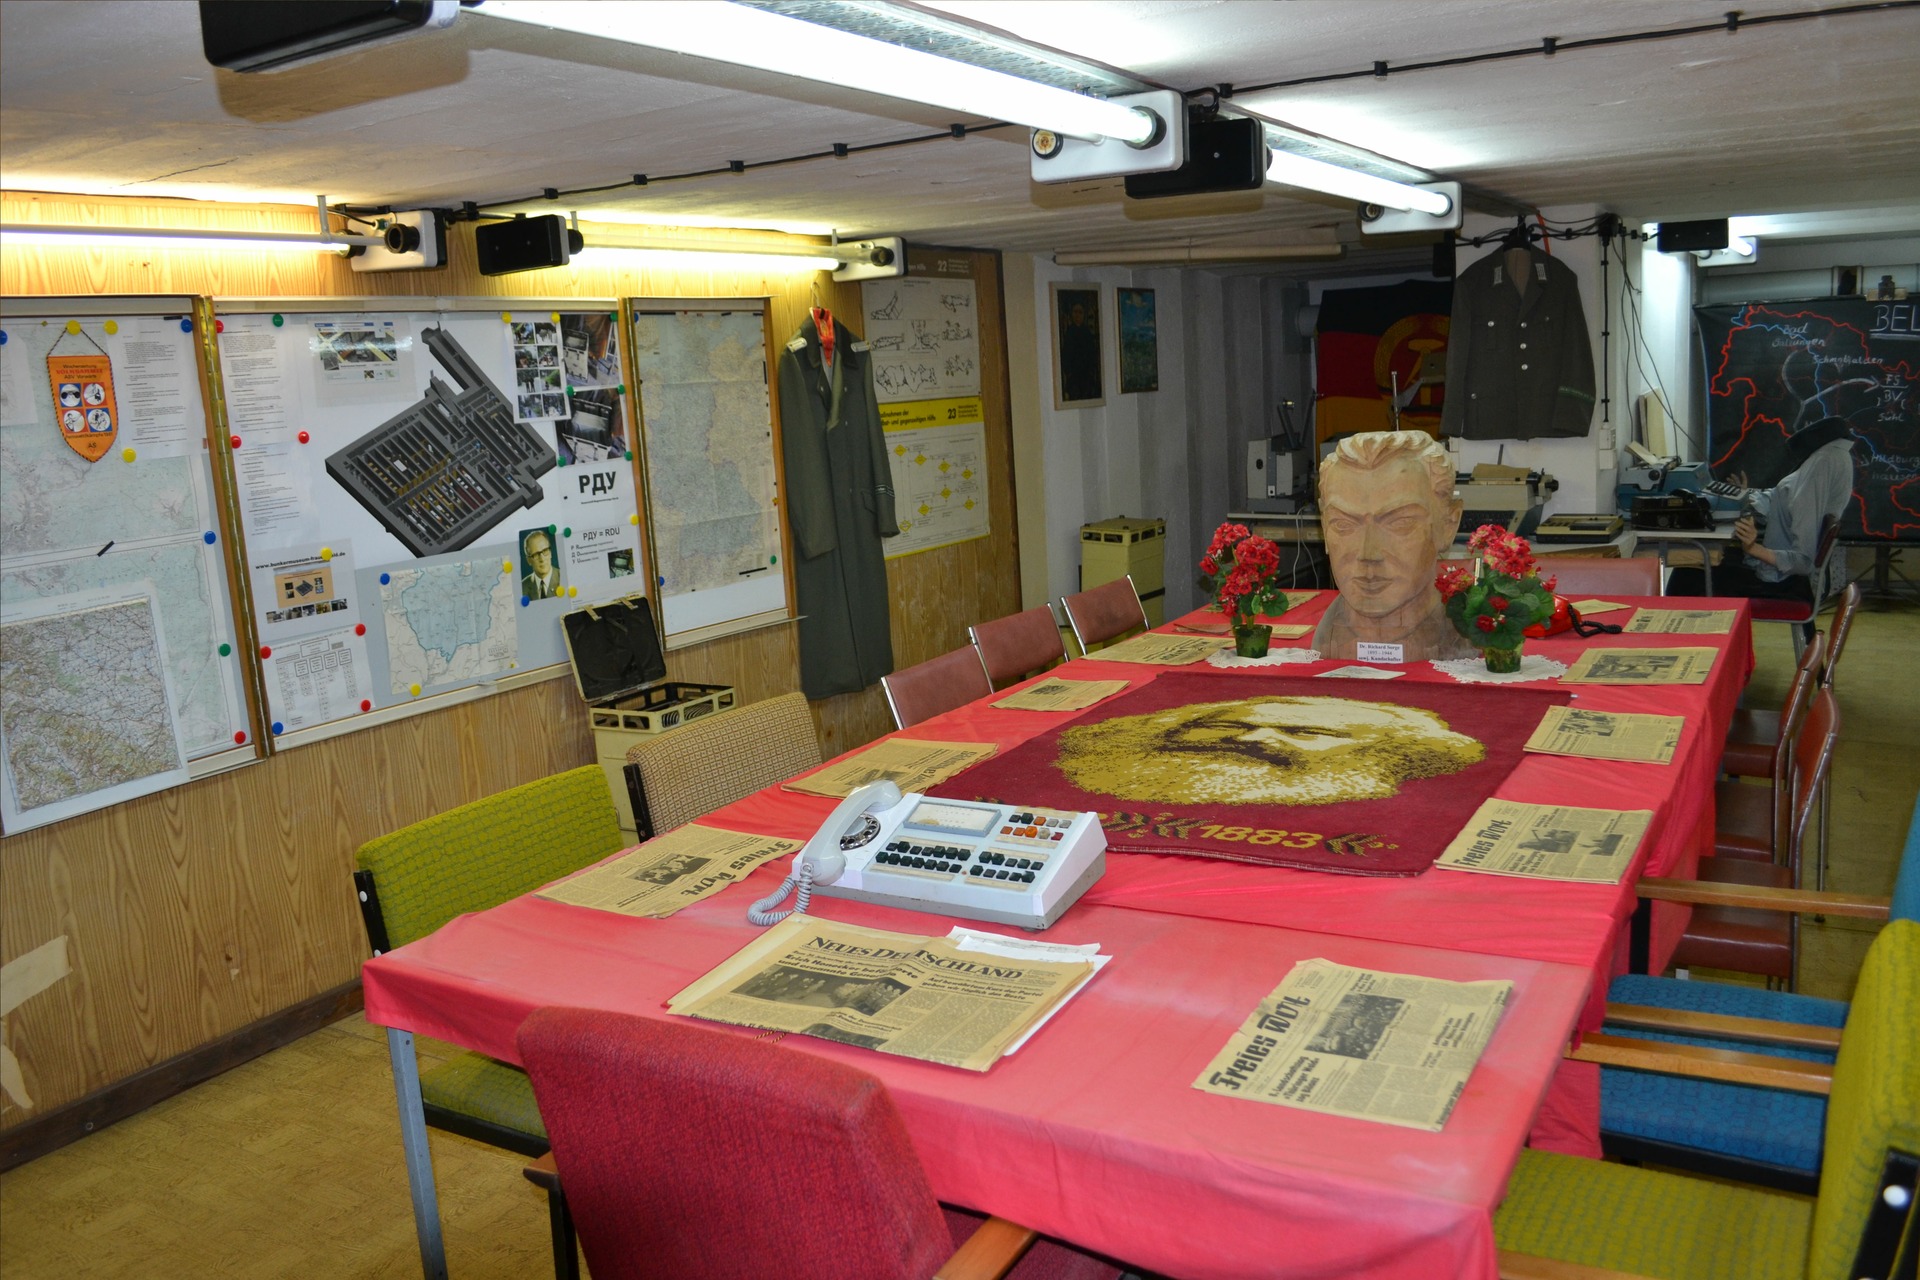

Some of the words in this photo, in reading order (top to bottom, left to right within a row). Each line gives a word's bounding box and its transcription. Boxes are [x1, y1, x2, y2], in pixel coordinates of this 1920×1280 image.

[947, 408, 957, 420] 23
[579, 471, 616, 496] РДУ
[583, 531, 597, 541] РДУ
[605, 527, 620, 537] RDU
[255, 552, 346, 569] www.bunkermuseum-frauald.de
[1200, 824, 1323, 848] 1883
[1477, 819, 1512, 841] Wort
[729, 840, 794, 871] Freies
[681, 872, 737, 896] Wort
[808, 936, 873, 956] NEUES
[784, 954, 809, 963] Erich
[812, 960, 860, 971] Honecker
[800, 964, 847, 975] ernannte
[922, 982, 946, 990] geben
[961, 987, 987, 995] täglich
[943, 979, 985, 990] bewährtem
[986, 984, 1002, 992] Kurs
[1208, 1034, 1278, 1091] Freies
[1256, 993, 1310, 1035] Wort
